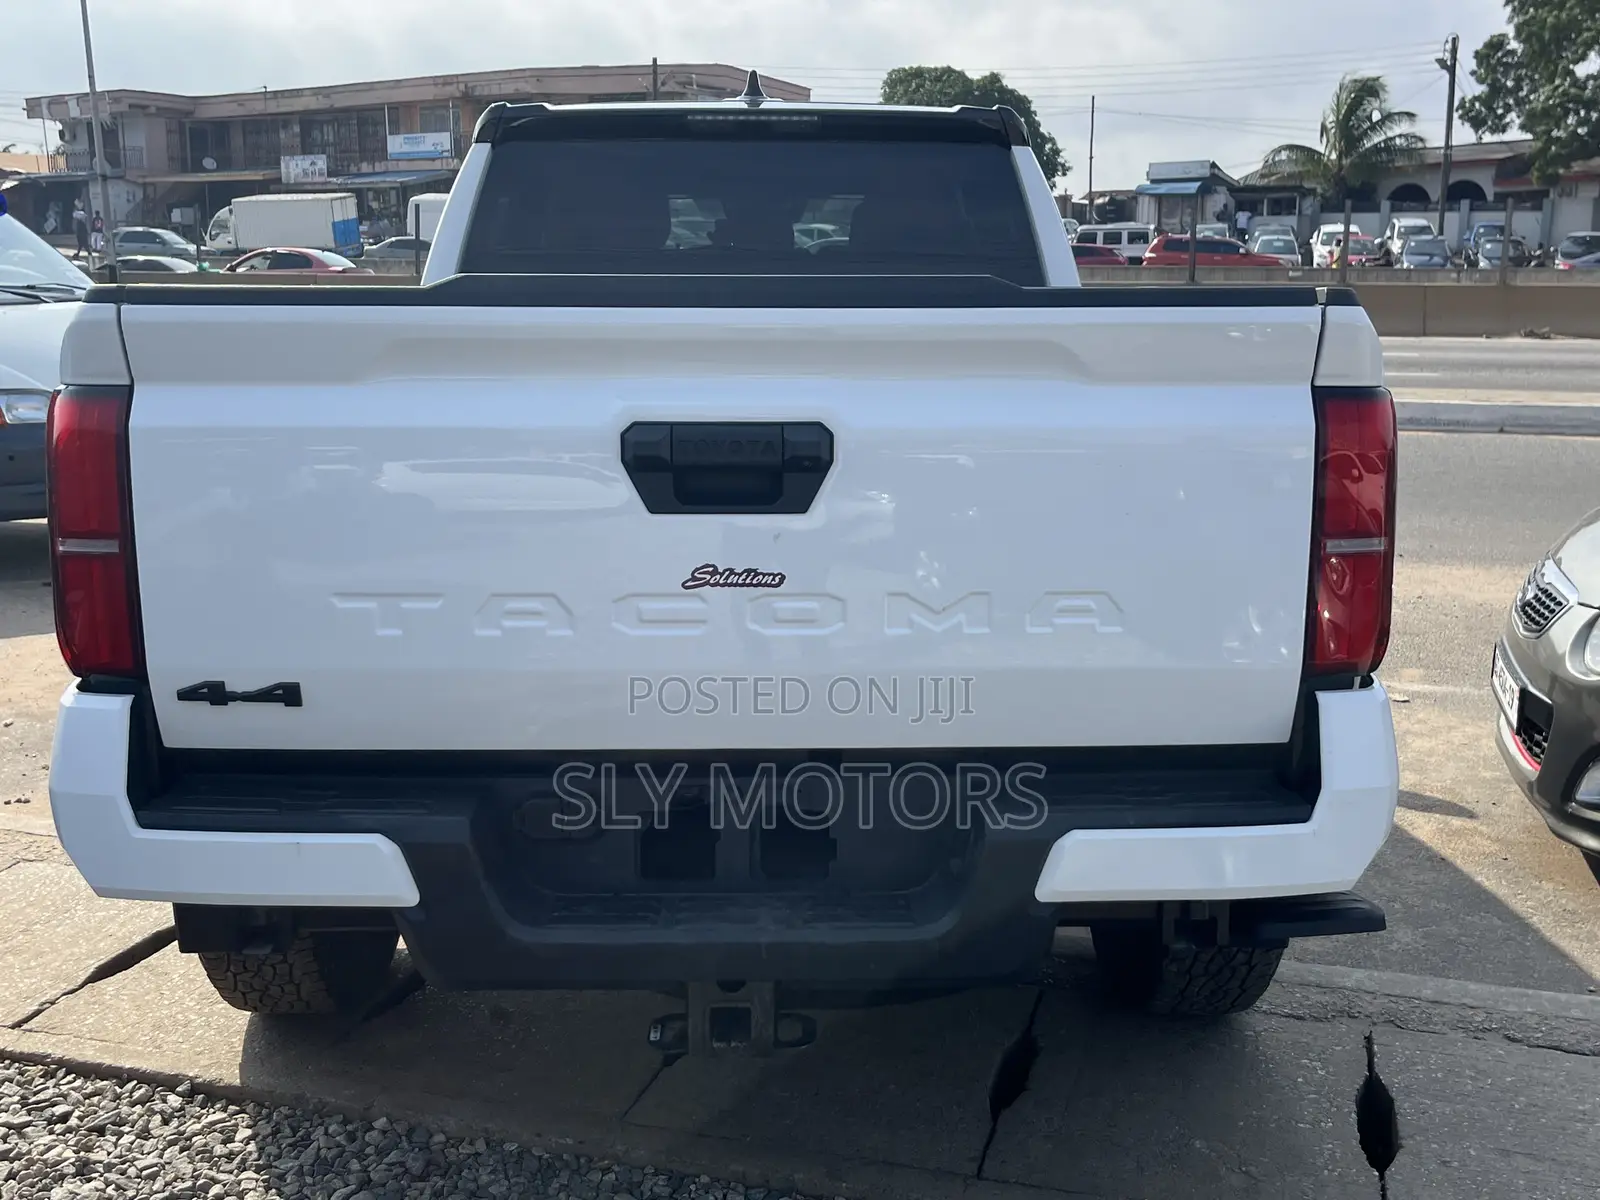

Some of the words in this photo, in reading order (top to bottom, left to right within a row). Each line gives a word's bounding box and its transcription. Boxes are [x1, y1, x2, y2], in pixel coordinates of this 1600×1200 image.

[678, 439, 778, 455] TOYOTA
[682, 564, 786, 589] Solutions
[330, 591, 1125, 637] TACOMA
